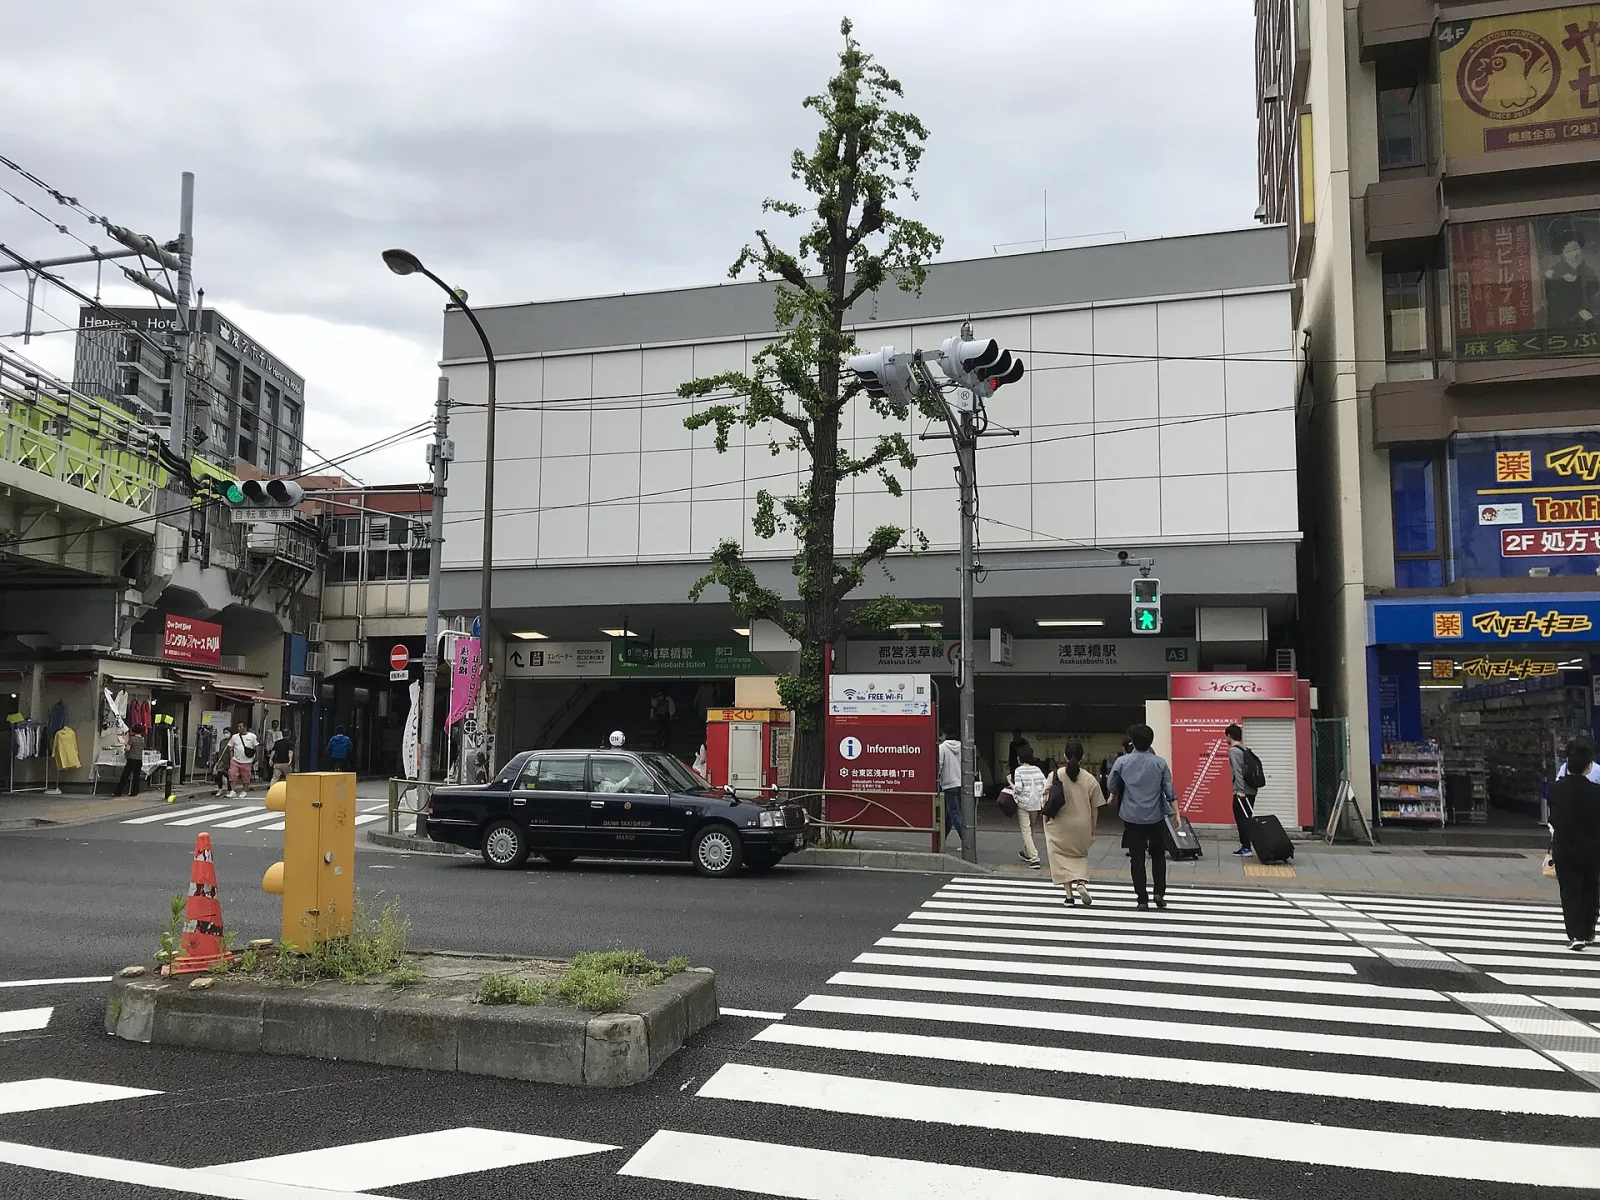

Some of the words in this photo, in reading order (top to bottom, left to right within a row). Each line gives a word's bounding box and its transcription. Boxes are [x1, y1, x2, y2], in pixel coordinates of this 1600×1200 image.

[1438, 27, 1465, 43] 4F
[1474, 30, 1508, 48] YAKITORI
[1510, 30, 1540, 41] CENTER
[1488, 111, 1511, 119] SINCE
[1507, 128, 1556, 143] 焼鳥全品
[148, 317, 178, 330] Hote
[1464, 332, 1598, 356] 麻雀くらぶ
[1497, 451, 1532, 481] 薬
[235, 509, 291, 519] 自転車専用
[1532, 496, 1581, 523] Tax
[1582, 495, 1600, 521] F
[1506, 534, 1535, 551] 2F
[1435, 613, 1461, 637] 薬
[1473, 610, 1592, 638] マツモトキヨシ
[165, 630, 206, 650] レンタルスペース
[715, 647, 733, 656] 東口
[878, 645, 944, 658] 都営浅草線
[1059, 644, 1116, 657] 浅草橋駅
[1168, 649, 1185, 660] A3
[1434, 660, 1452, 677] 薬
[1462, 658, 1559, 680] マツモトキヨシ
[867, 693, 885, 701] FREE
[885, 693, 904, 701] Wi-Fi
[722, 710, 755, 720] 宝くじ
[867, 744, 921, 754] Information
[851, 768, 915, 778] 台東区浅草橋1丁目
